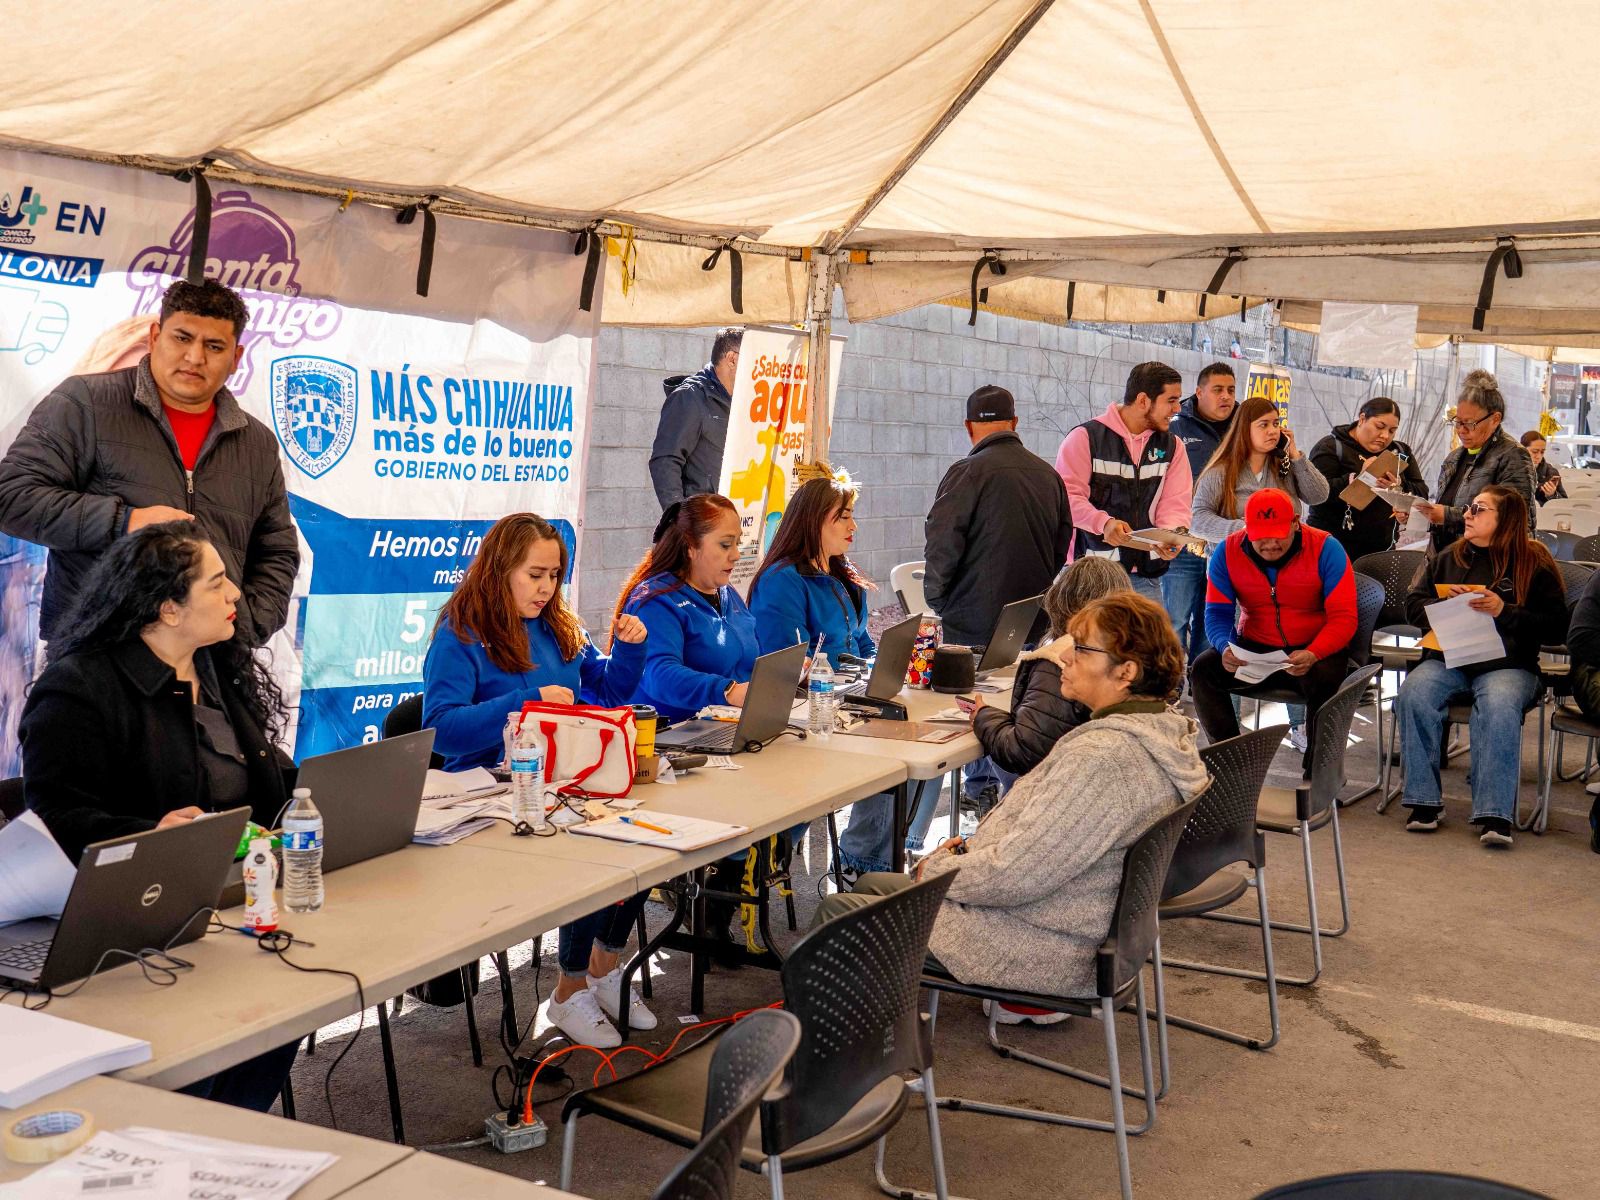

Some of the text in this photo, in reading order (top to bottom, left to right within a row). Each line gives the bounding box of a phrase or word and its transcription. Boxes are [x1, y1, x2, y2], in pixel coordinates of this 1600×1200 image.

[56, 201, 106, 236] EN
[0, 250, 91, 284] LONIA
[794, 365, 808, 380] cu
[371, 363, 573, 432] MÁS CHIHUAHUA
[374, 423, 573, 459] más de lo bueno
[296, 451, 332, 474] LEALTAD
[374, 458, 569, 482] GOBIERNO DEL ESTADO
[369, 530, 459, 558] Hemos
[433, 565, 464, 585] más
[352, 693, 393, 714] para
